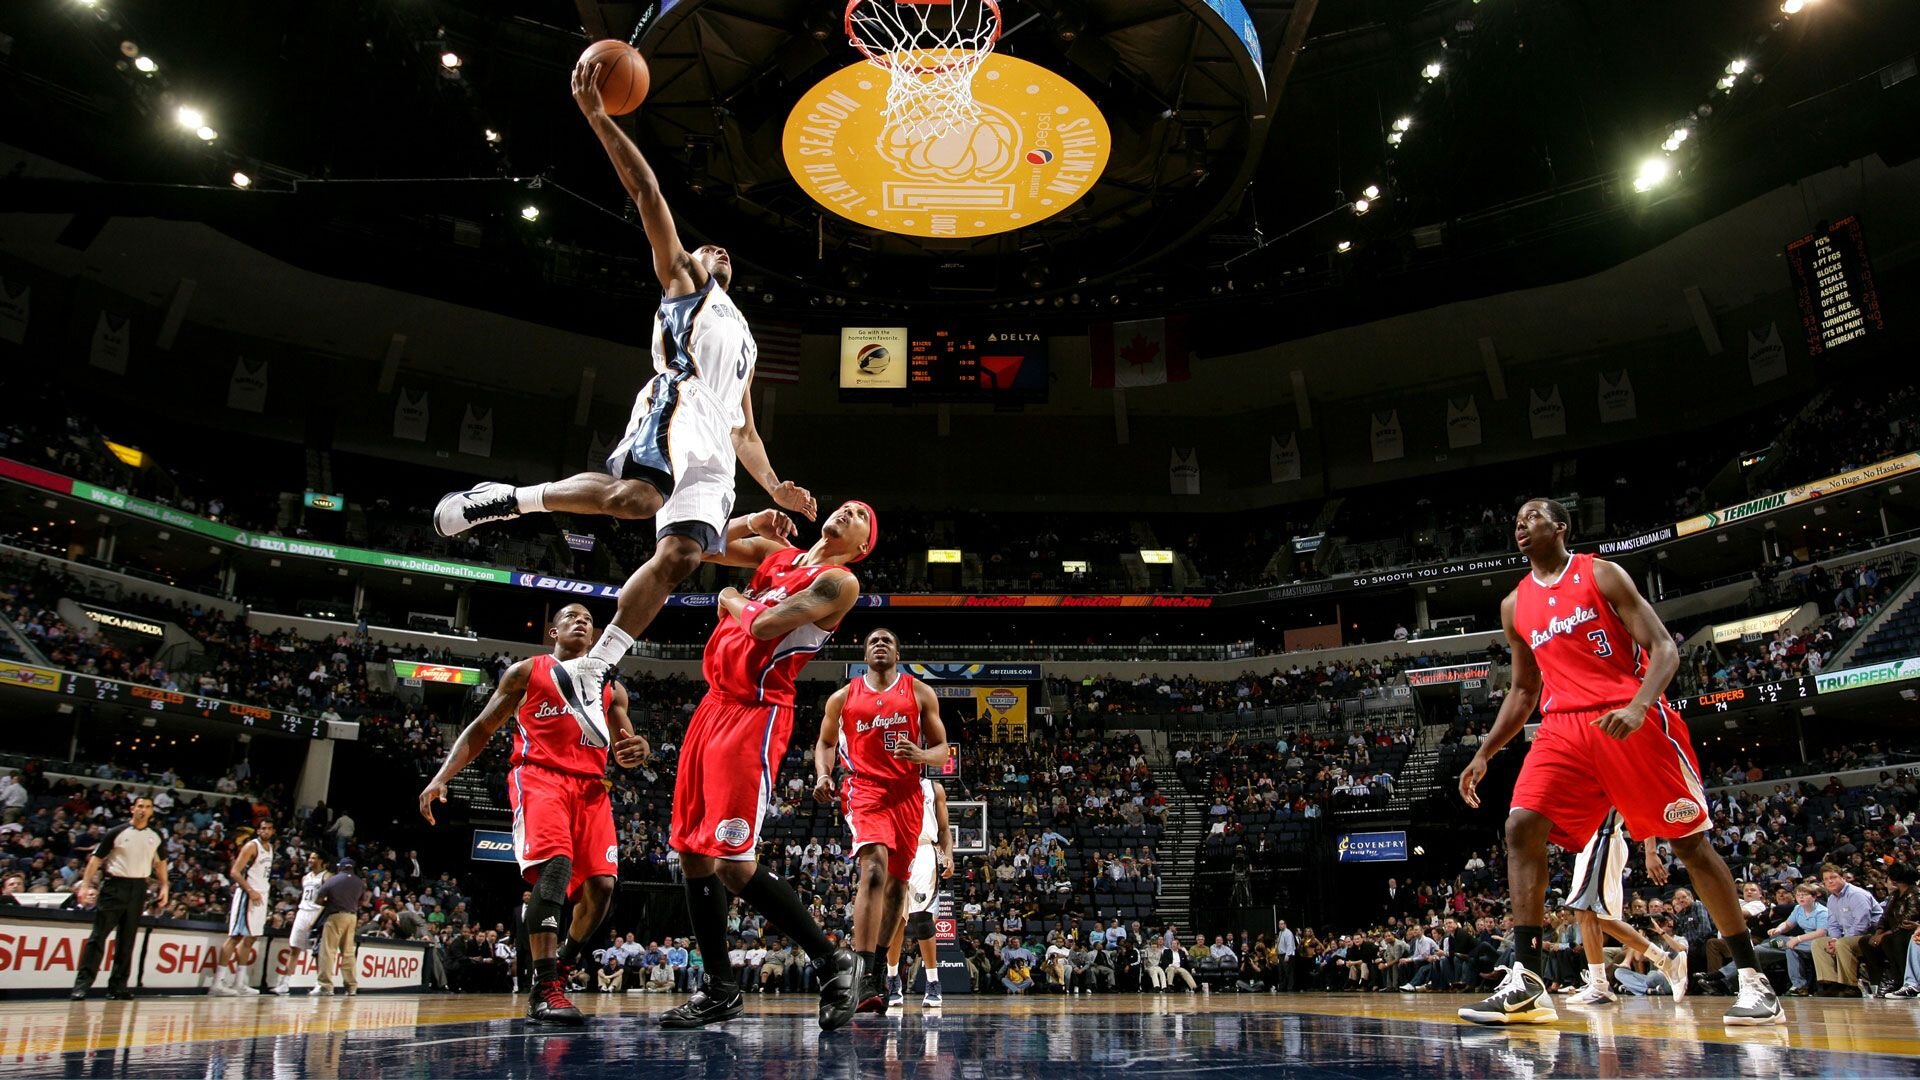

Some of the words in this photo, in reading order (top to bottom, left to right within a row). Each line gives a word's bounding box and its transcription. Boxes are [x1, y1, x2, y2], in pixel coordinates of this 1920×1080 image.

[799, 89, 862, 157] SEASON
[1035, 112, 1052, 148] pepsi
[1046, 117, 1096, 195] MEMPHIS
[803, 163, 866, 212] TENTH
[931, 214, 958, 235] 2001
[1815, 235, 1830, 247] FG%
[1817, 245, 1832, 257] FT%
[1818, 257, 1827, 267] PT
[1828, 251, 1841, 263] FGS
[1816, 262, 1842, 278] BLOCKS
[1819, 271, 1844, 287] STEALS
[1820, 281, 1848, 298] ASSISTS
[1821, 297, 1835, 308] OFF.
[1835, 290, 1852, 302] REB.
[1823, 308, 1838, 318] DEF.
[1838, 301, 1854, 313] REB.
[1821, 308, 1861, 329] TURNOVERS
[1822, 328, 1835, 340] PTS
[1835, 325, 1844, 335] IN
[1844, 317, 1865, 332] PAINT
[1000, 333, 1040, 342] DELTA
[1825, 334, 1855, 349] FASTBREAK
[1855, 328, 1867, 338] PTS
[1828, 480, 1842, 489] No
[1842, 474, 1862, 487] Bugs.
[1863, 470, 1876, 480] No
[1876, 462, 1906, 475] Hassles.
[91, 489, 109, 503] We
[110, 496, 124, 508] do
[125, 500, 160, 519] dental.
[161, 512, 194, 528] Better.
[1723, 491, 1787, 522] TERMINIX
[250, 538, 287, 552] DELTA
[288, 543, 336, 559] DENTAL
[1599, 542, 1616, 554] NEW
[1616, 531, 1659, 552] AMSTERDAM
[1659, 528, 1671, 541] GIN
[383, 558, 495, 580] www.DeltaDentalTn.com
[1353, 578, 1367, 587] SO
[1371, 572, 1413, 584] SMOOTH
[1417, 568, 1438, 578] YOU
[1442, 565, 1464, 574] CAN
[1469, 559, 1503, 571] DRINK
[1507, 557, 1517, 565] IT
[536, 577, 594, 594] BUD
[1268, 591, 1282, 600] NEW
[1282, 583, 1322, 599] AMSTERDAM
[964, 595, 1026, 607] AutoZone
[1061, 595, 1123, 607] AutoZone
[1152, 595, 1213, 608] AutoZone
[121, 619, 163, 637] MINOLTA
[1530, 629, 1550, 650] Los
[1549, 606, 1598, 637] Angeles
[1744, 632, 1761, 641] 116A
[1587, 628, 1613, 658] 3
[990, 668, 1033, 676] GRIZZLIES.COM
[66, 684, 75, 694] 5
[96, 689, 105, 700] 2
[130, 686, 185, 705] GRIZZLIES
[948, 687, 971, 697] BAND
[1699, 689, 1745, 706] CLIPPERS
[1771, 692, 1777, 702] 2
[1799, 687, 1806, 697] 2
[196, 698, 221, 711] 2:17
[228, 704, 272, 720] CLIPPERS
[535, 701, 559, 718] Los
[1715, 702, 1728, 713] 74
[242, 715, 255, 726] 74
[856, 720, 870, 733] Los
[872, 712, 908, 729] Angeles
[289, 723, 297, 733] 2
[311, 727, 319, 737] 2
[1666, 808, 1696, 821] CLIPPERS
[476, 840, 513, 851] BUD
[1349, 840, 1404, 849] COVENTRY
[304, 888, 314, 903] 21
[361, 954, 419, 978] SHARP
